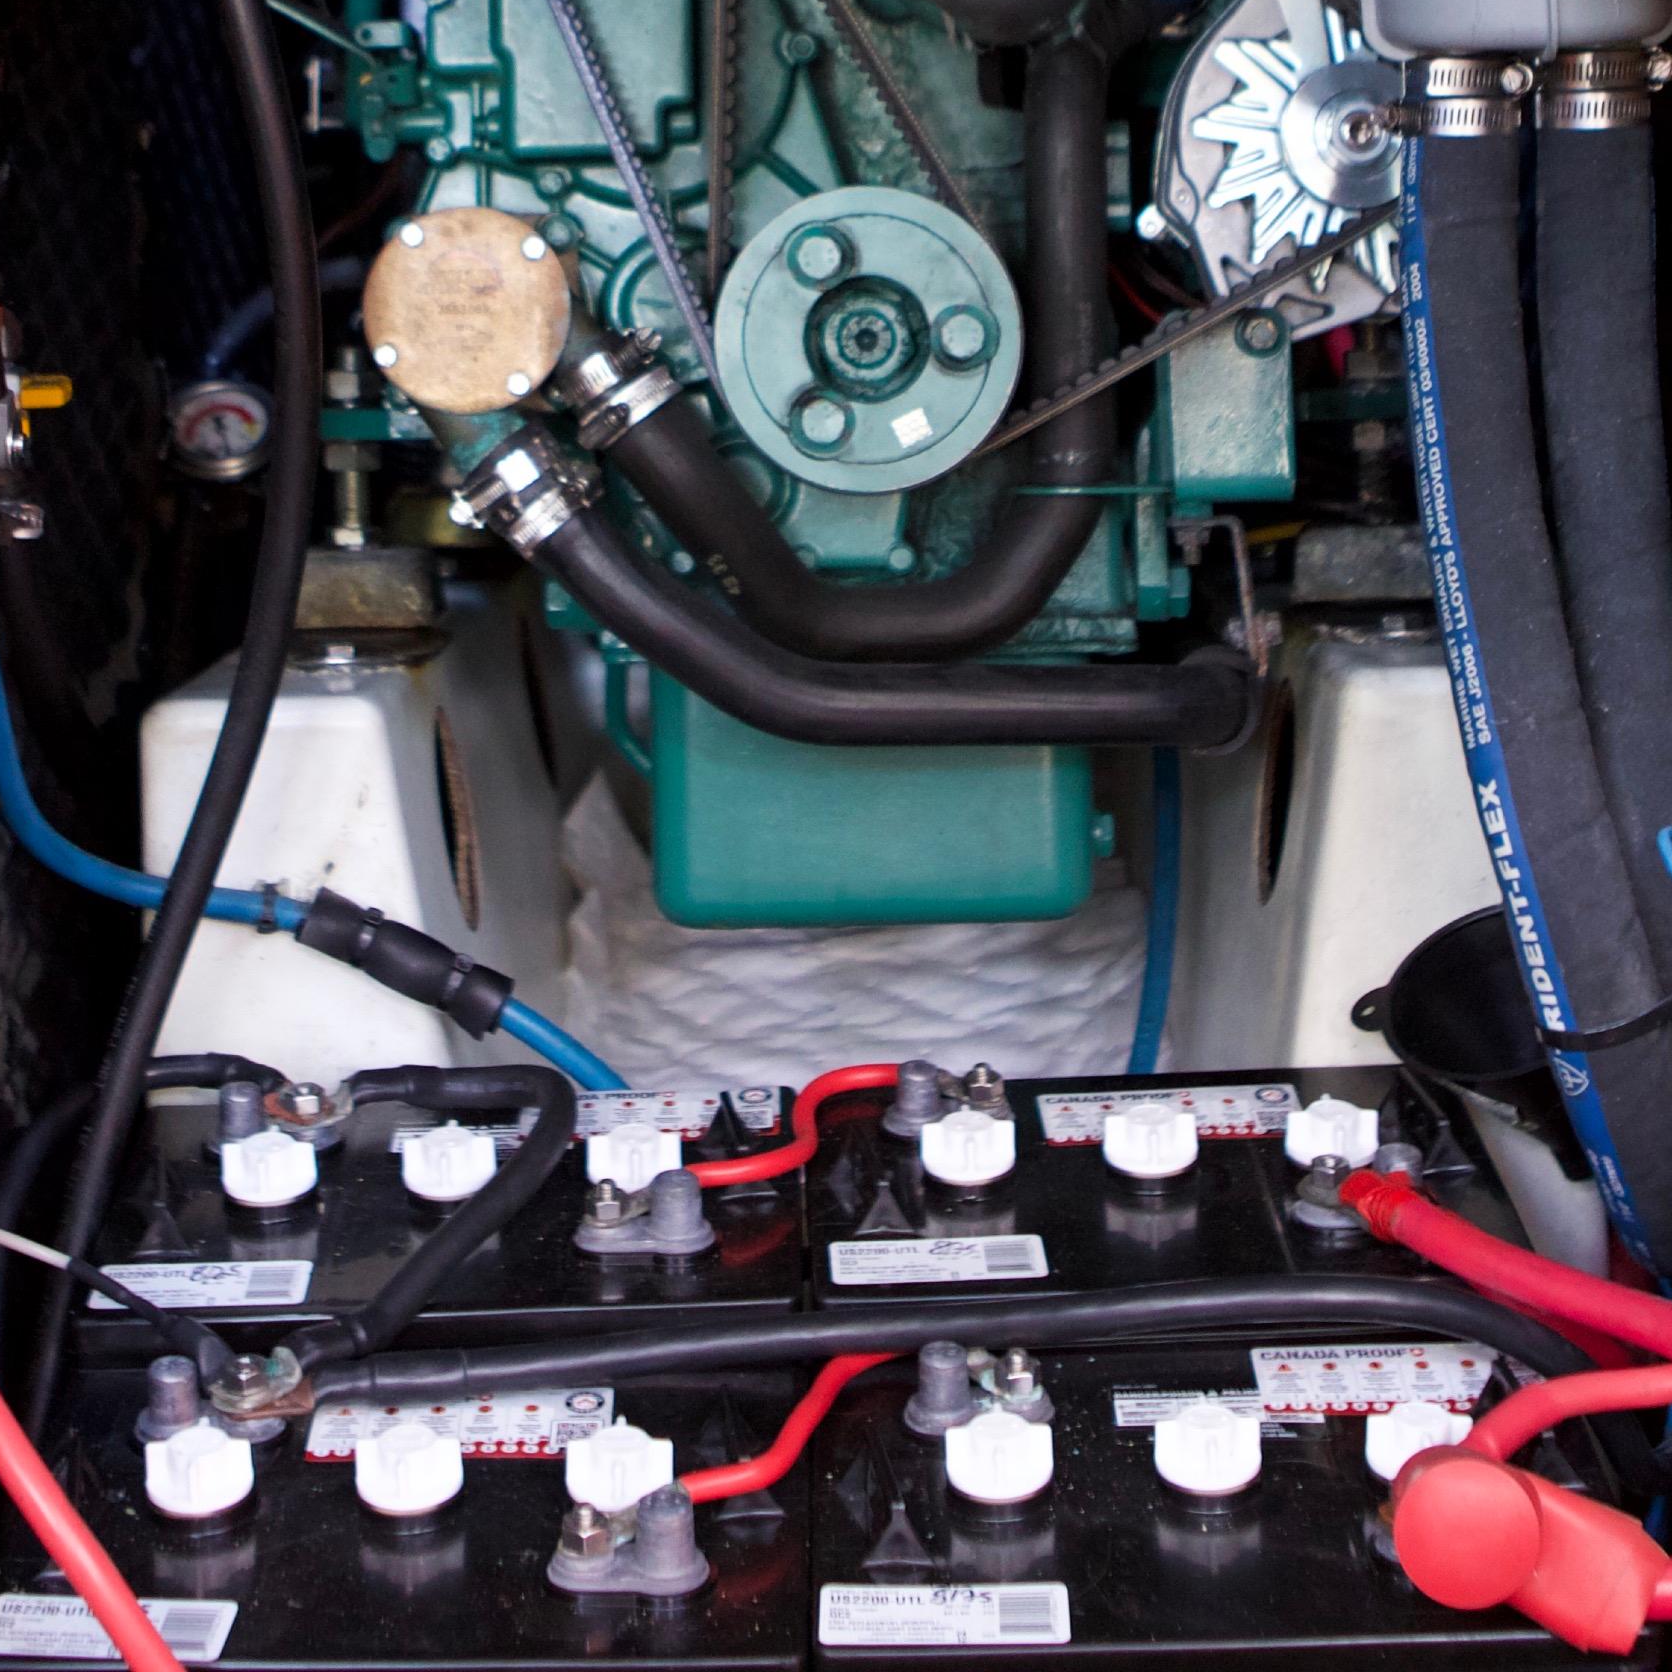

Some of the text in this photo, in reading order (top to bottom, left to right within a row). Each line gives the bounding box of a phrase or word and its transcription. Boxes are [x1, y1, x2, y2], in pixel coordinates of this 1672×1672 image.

[1409, 262, 1423, 302] 2004
[1422, 397, 1439, 444] CERT
[1415, 422, 1427, 471] HOSE
[1420, 473, 1435, 534] WATER
[1428, 447, 1453, 547] APPROVED
[1433, 554, 1454, 632] EXHAUST
[1443, 550, 1468, 630] LLOYD'S
[1447, 637, 1463, 675] WET
[1454, 677, 1476, 749] MARINE
[1473, 702, 1492, 745] SAE
[1478, 779, 1566, 1055] RIDENT-FLEX
[1046, 1091, 1176, 1105] CANADA PROOF
[1260, 1347, 1407, 1361] CANADA PROOF
